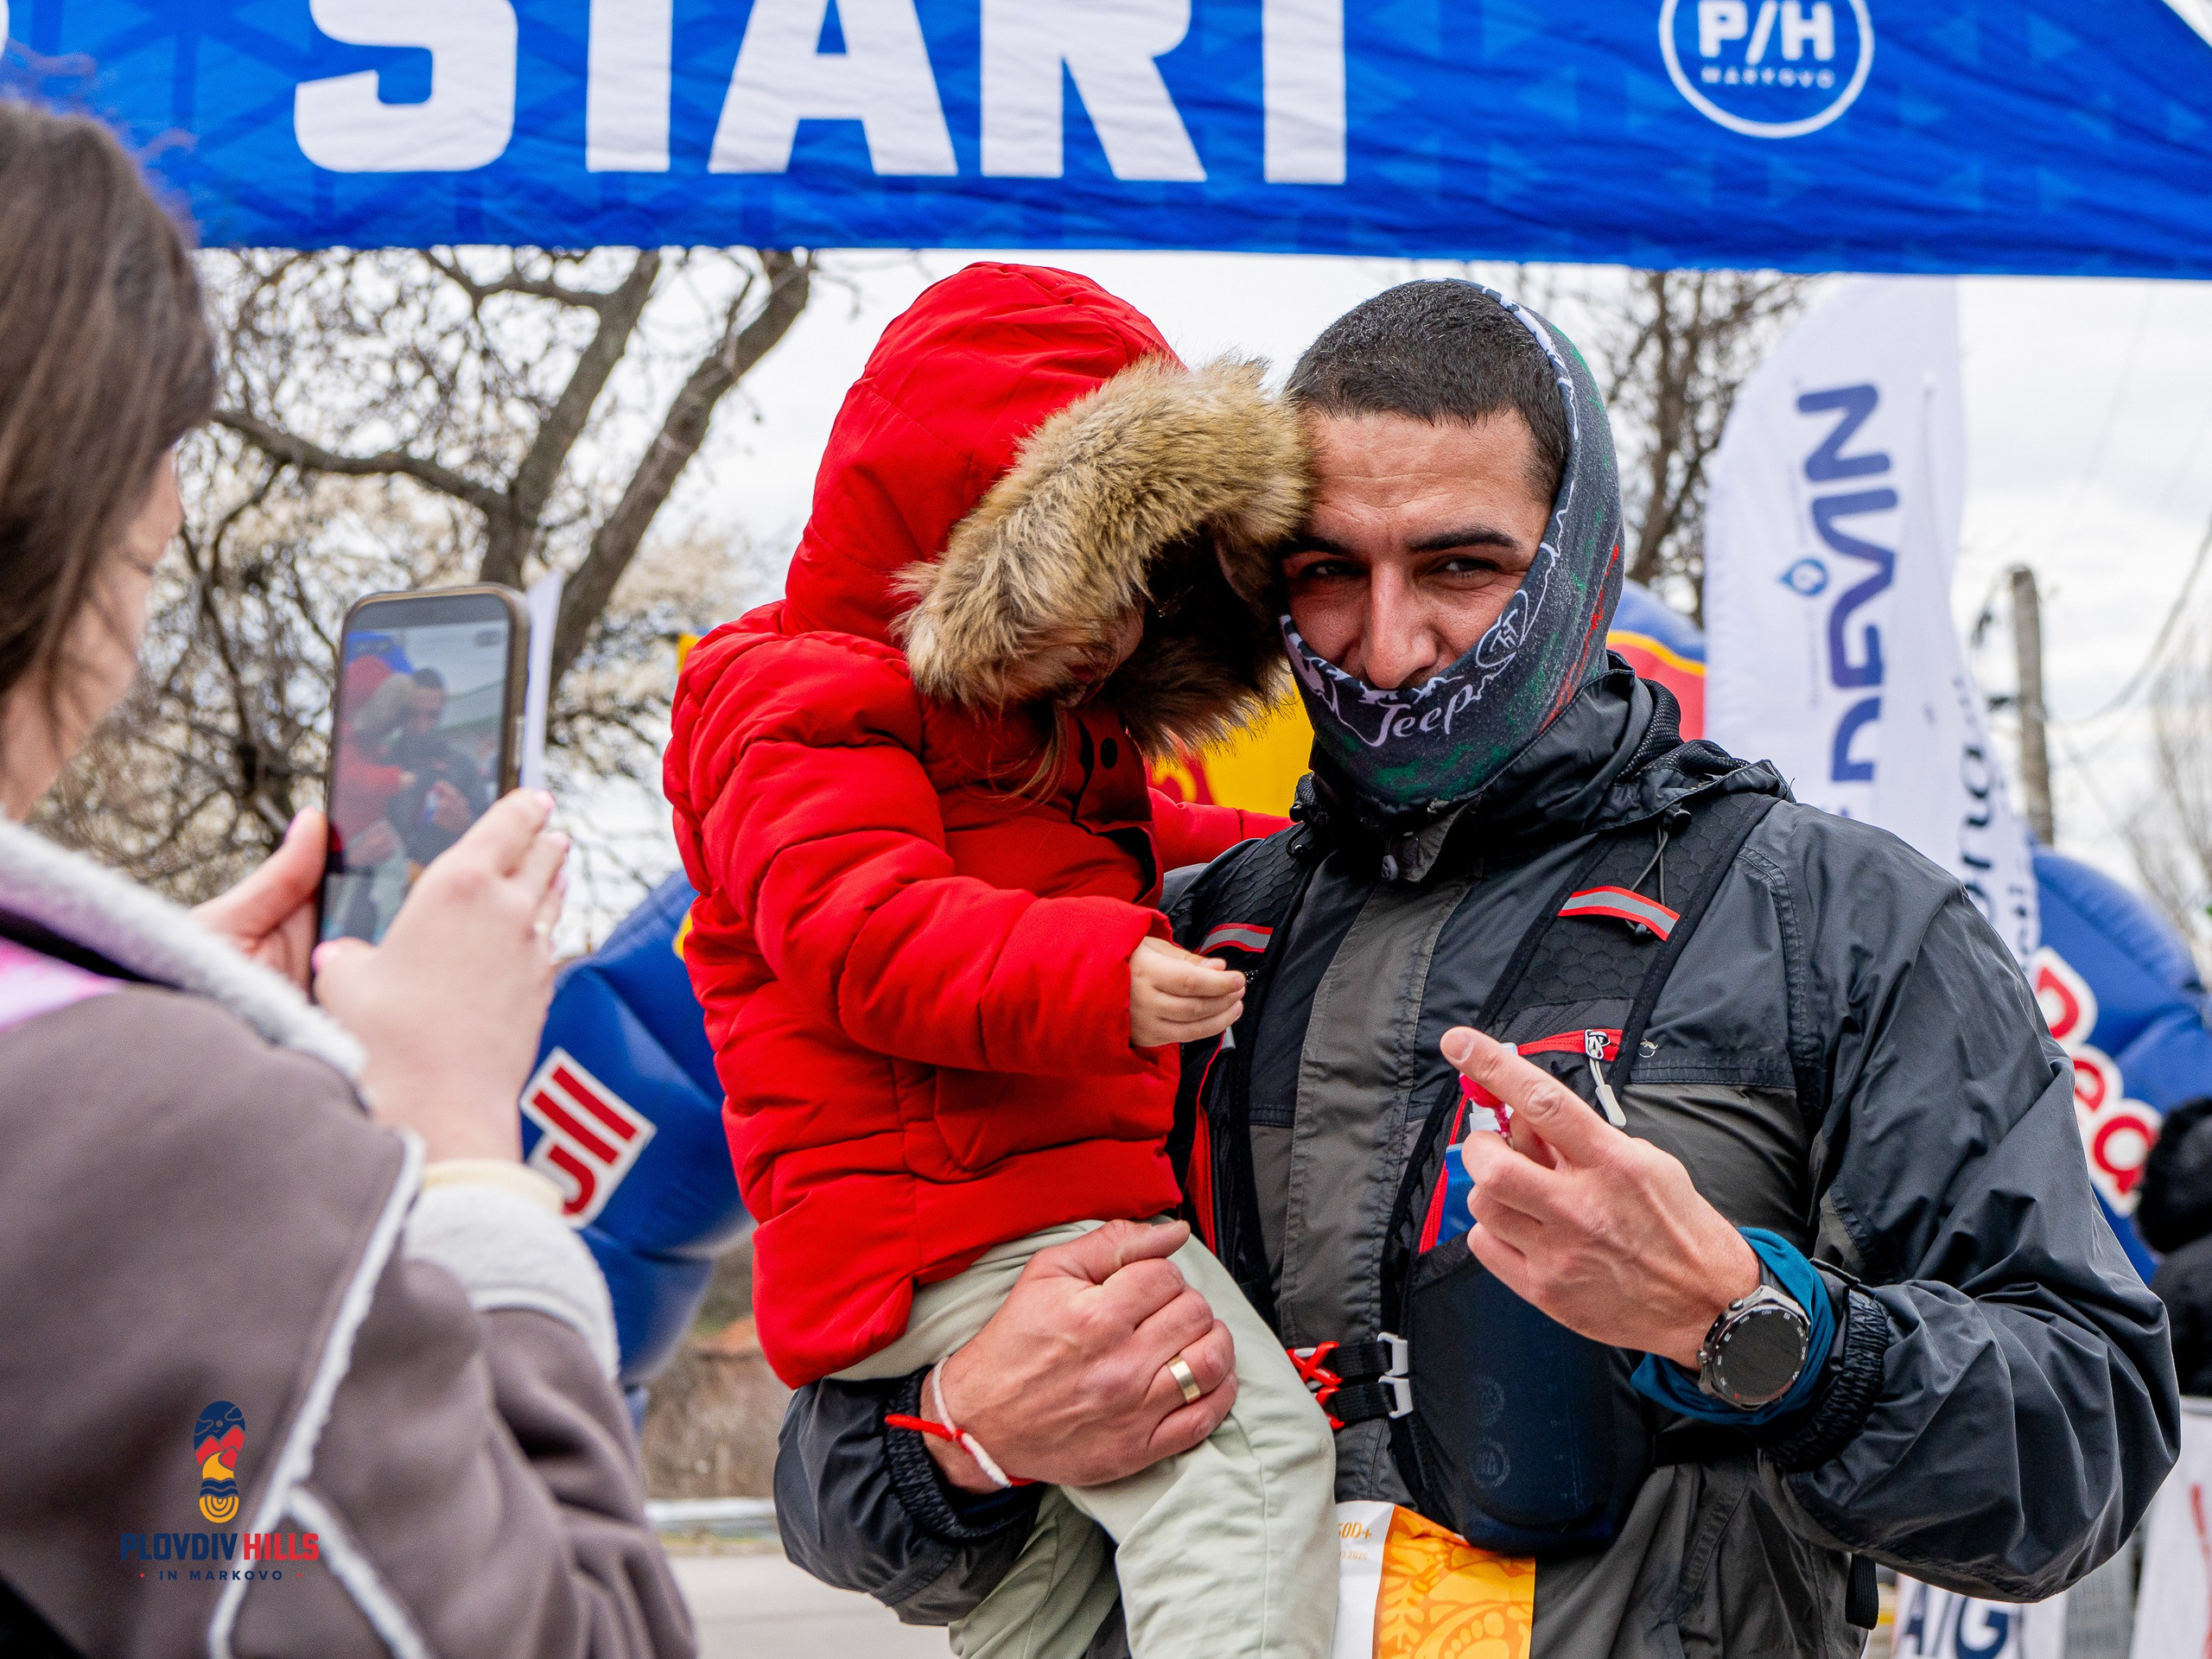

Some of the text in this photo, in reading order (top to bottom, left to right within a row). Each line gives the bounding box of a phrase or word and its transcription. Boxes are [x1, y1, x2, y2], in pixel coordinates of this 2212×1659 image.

[1698, 0, 1835, 66] P/H
[294, 0, 1346, 184] START
[1363, 683, 1474, 747] Jeep
[531, 1065, 638, 1217] ull
